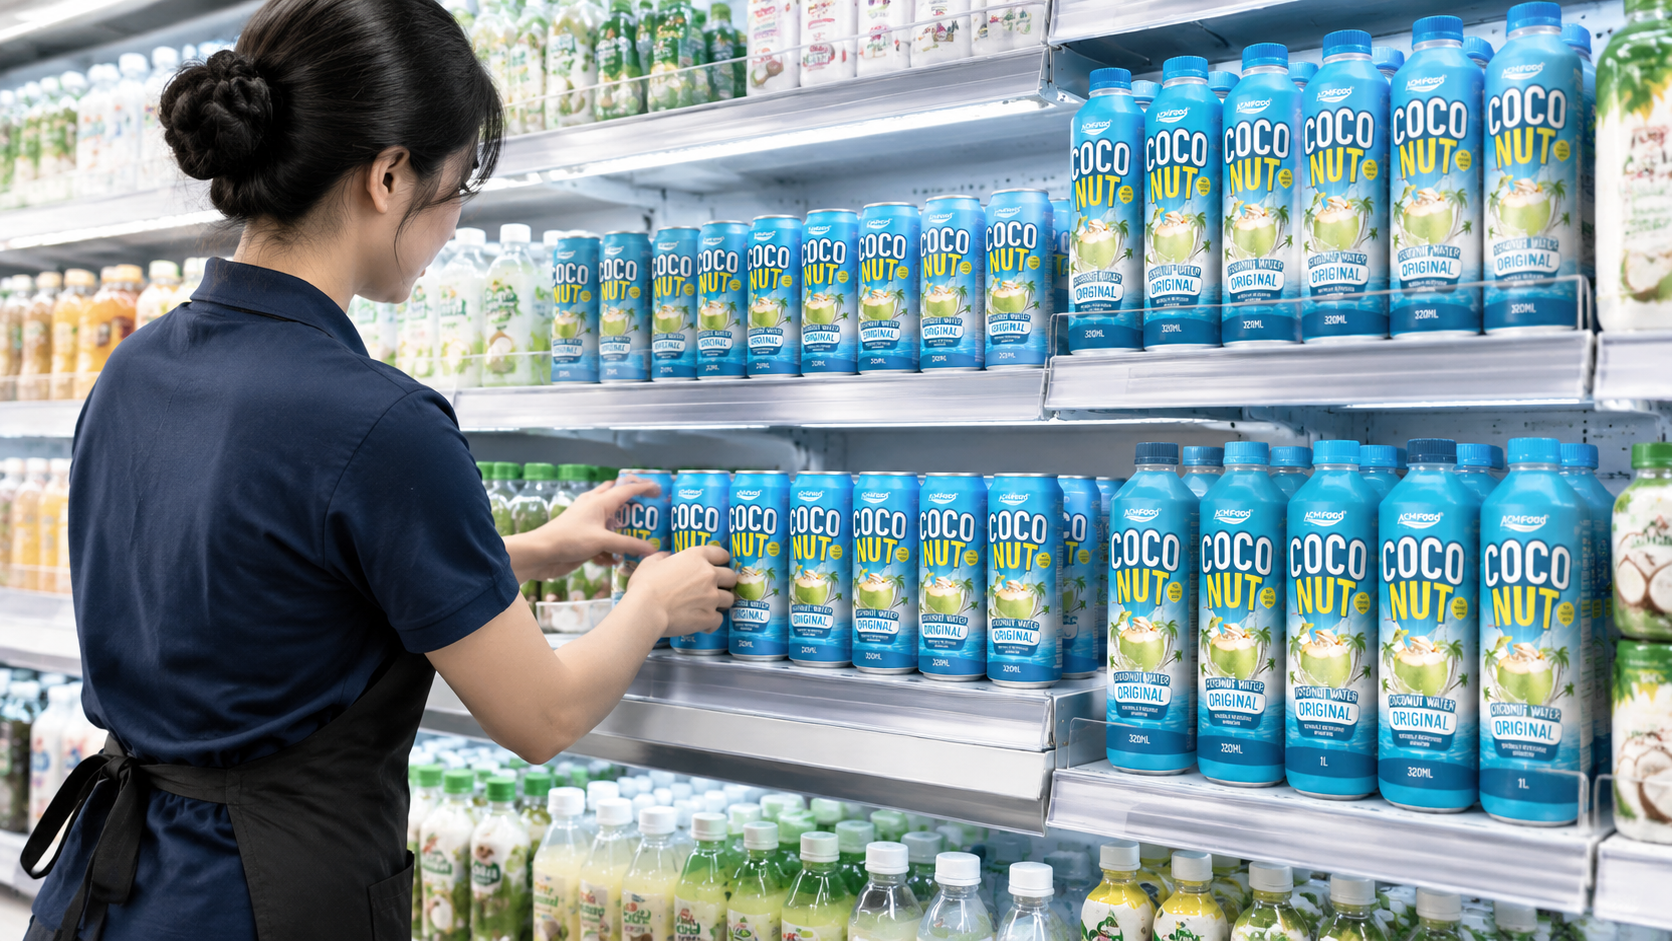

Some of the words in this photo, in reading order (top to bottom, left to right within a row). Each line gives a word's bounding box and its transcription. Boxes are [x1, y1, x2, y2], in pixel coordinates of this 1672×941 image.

[1394, 97, 1467, 147] COCO
[1488, 85, 1565, 138] COCO
[1225, 119, 1289, 168] COCO
[1305, 108, 1373, 154] COCO
[1146, 129, 1207, 171] COCO
[1400, 138, 1458, 178] NUT
[1496, 127, 1558, 167] NUT
[1070, 139, 1130, 184] COCO
[1230, 157, 1282, 194] NUT
[1310, 148, 1363, 186] NUT
[1076, 175, 1122, 211] NUT
[1151, 166, 1200, 203] NUT
[859, 233, 906, 261] COCO
[920, 226, 969, 261] COCO
[986, 220, 1037, 251] COCO
[697, 249, 738, 275] COCO
[748, 245, 789, 270] COCO
[802, 239, 846, 268] COCO
[924, 254, 961, 277] NUT
[990, 248, 1030, 273] NUT
[1402, 260, 1454, 275] ORIGINAL
[1496, 252, 1553, 270] ORIGINAL
[599, 256, 637, 286] COCO
[652, 254, 692, 282] COCO
[750, 268, 782, 289] NUT
[805, 264, 838, 285] NUT
[862, 259, 900, 282] NUT
[1231, 273, 1277, 290] ORIGINAL
[1312, 267, 1361, 283] ORIGINAL
[554, 284, 584, 302] NUT
[602, 281, 630, 300] NUT
[655, 277, 686, 297] NUT
[700, 272, 731, 293] NUT
[1152, 279, 1195, 294] ORIGINAL
[1324, 314, 1347, 325] 320ML
[1415, 309, 1439, 319] 320ML
[671, 504, 718, 532] COCO
[729, 505, 777, 534] COCO
[790, 506, 840, 537] COCO
[853, 508, 906, 539] COCO
[920, 509, 974, 542] COCO
[989, 511, 1047, 543] COCO
[732, 533, 770, 557] NUT
[793, 535, 834, 560] NUT
[857, 537, 899, 563] NUT
[924, 540, 965, 567] NUT
[994, 542, 1040, 570] NUT
[1112, 529, 1179, 575] COCO
[1202, 532, 1272, 575] COCO
[1290, 534, 1366, 580] COCO
[1383, 537, 1464, 585] COCO
[1485, 540, 1570, 589] COCO
[1117, 569, 1172, 604] NUT
[1207, 573, 1264, 610] NUT
[1296, 577, 1357, 616] NUT
[1390, 581, 1455, 622] NUT
[1493, 586, 1560, 628] NUT
[994, 630, 1034, 643] ORIGINAL
[1117, 685, 1164, 702] ORIGINAL
[1209, 692, 1258, 711] ORIGINAL
[1299, 702, 1352, 721] ORIGINAL
[1392, 711, 1449, 731] ORIGINAL
[1128, 733, 1151, 744] 320ML
[1494, 720, 1554, 741] ORIGINAL
[1320, 756, 1328, 767] 1L
[1407, 767, 1433, 778] 320ML
[1517, 778, 1529, 789] 1L
